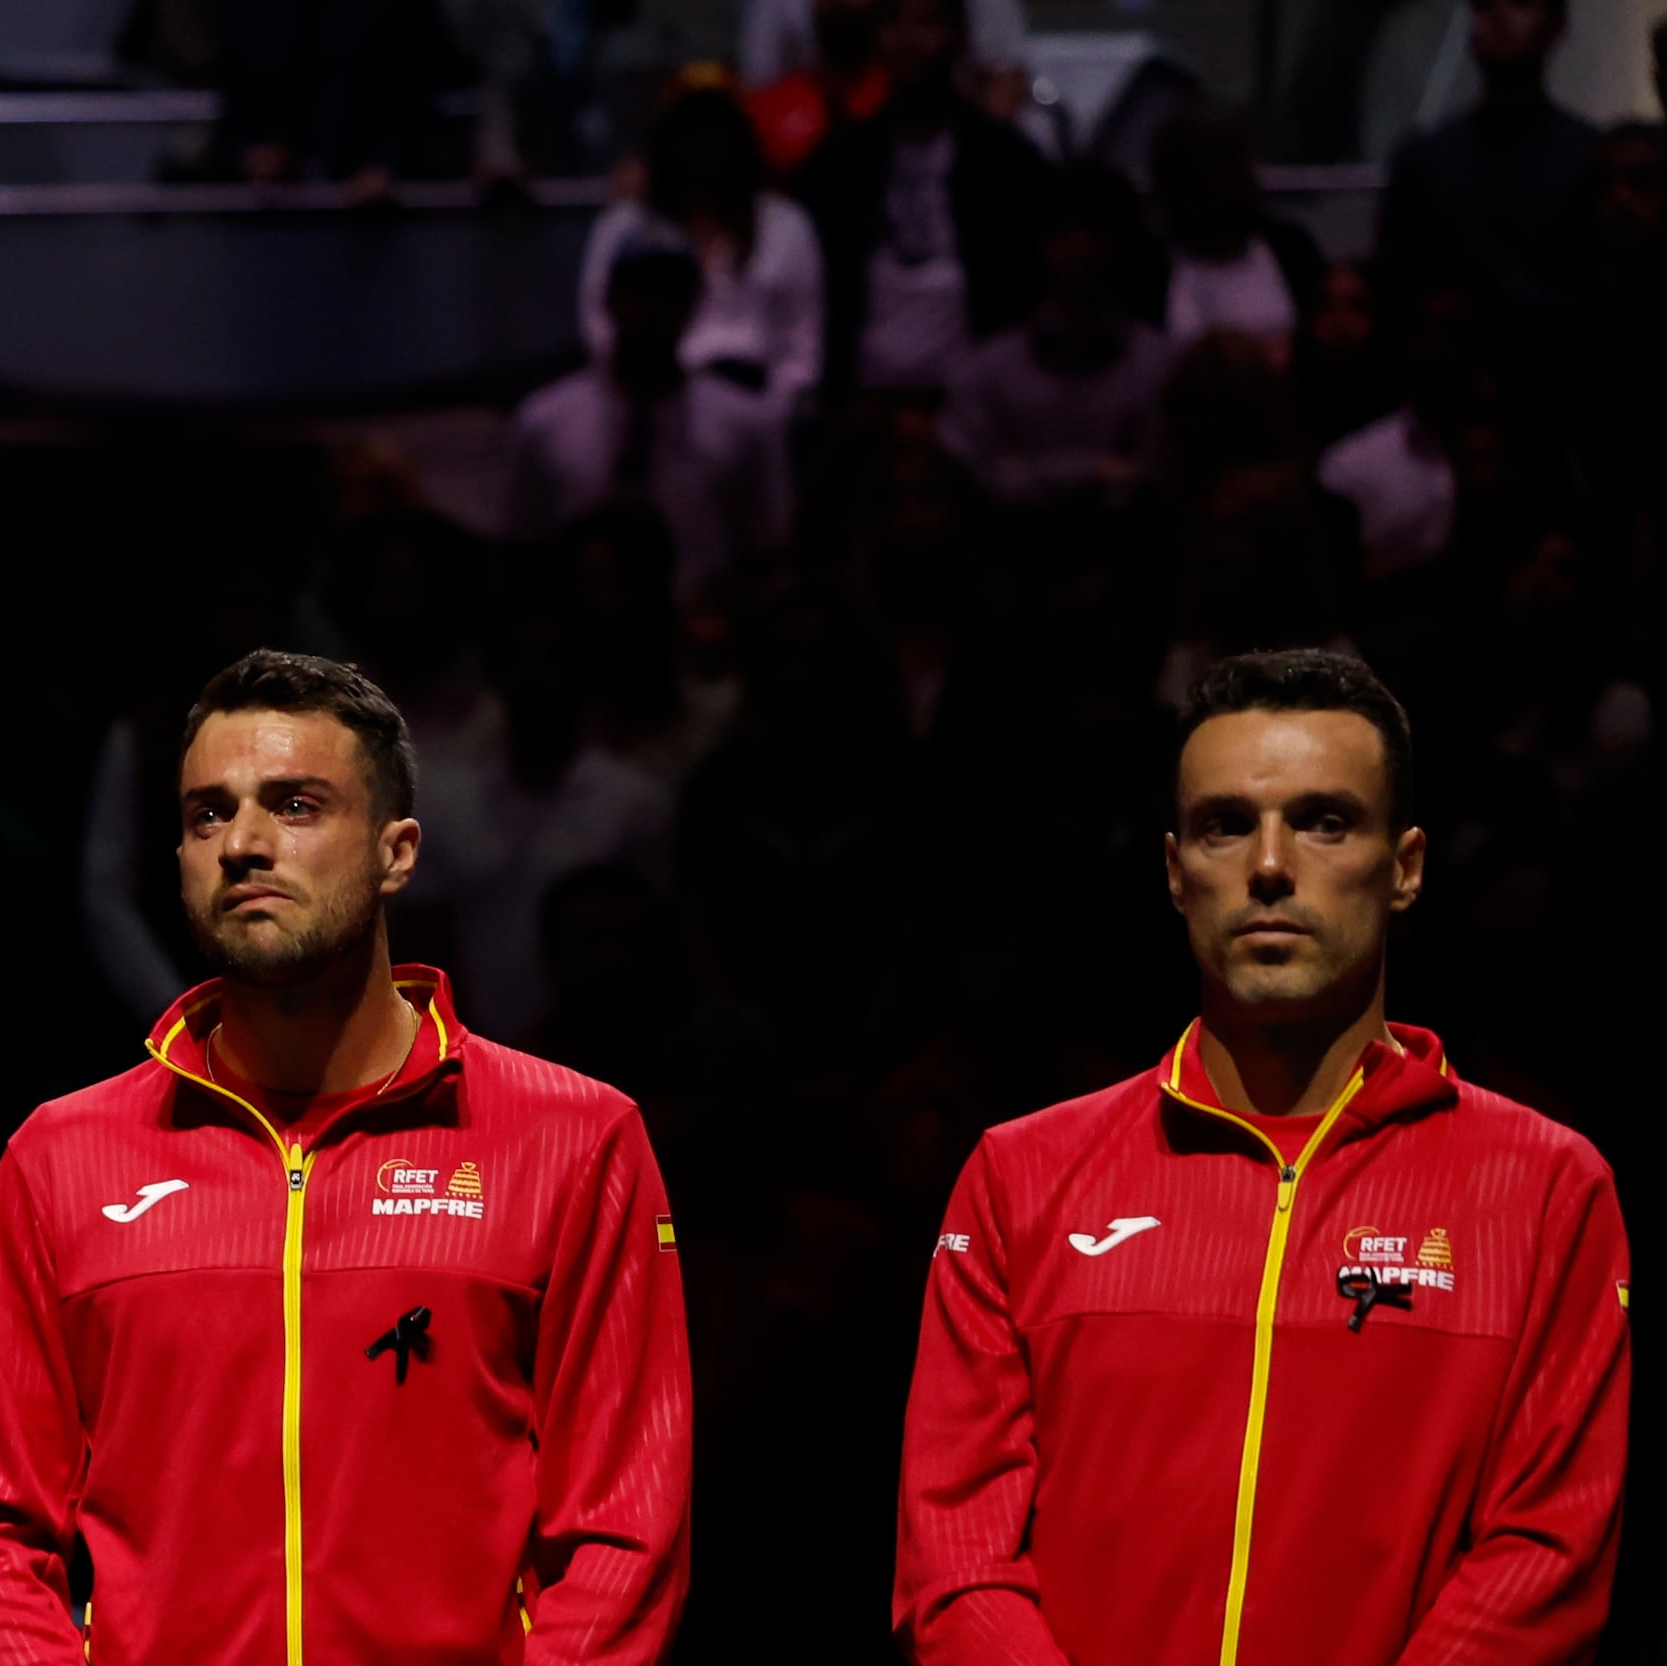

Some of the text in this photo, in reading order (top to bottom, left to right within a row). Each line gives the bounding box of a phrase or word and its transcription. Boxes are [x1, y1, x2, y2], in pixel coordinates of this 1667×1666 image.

[393, 1169, 438, 1184] RFET
[372, 1198, 484, 1219] MAPFRE
[1361, 1237, 1407, 1252] RFET
